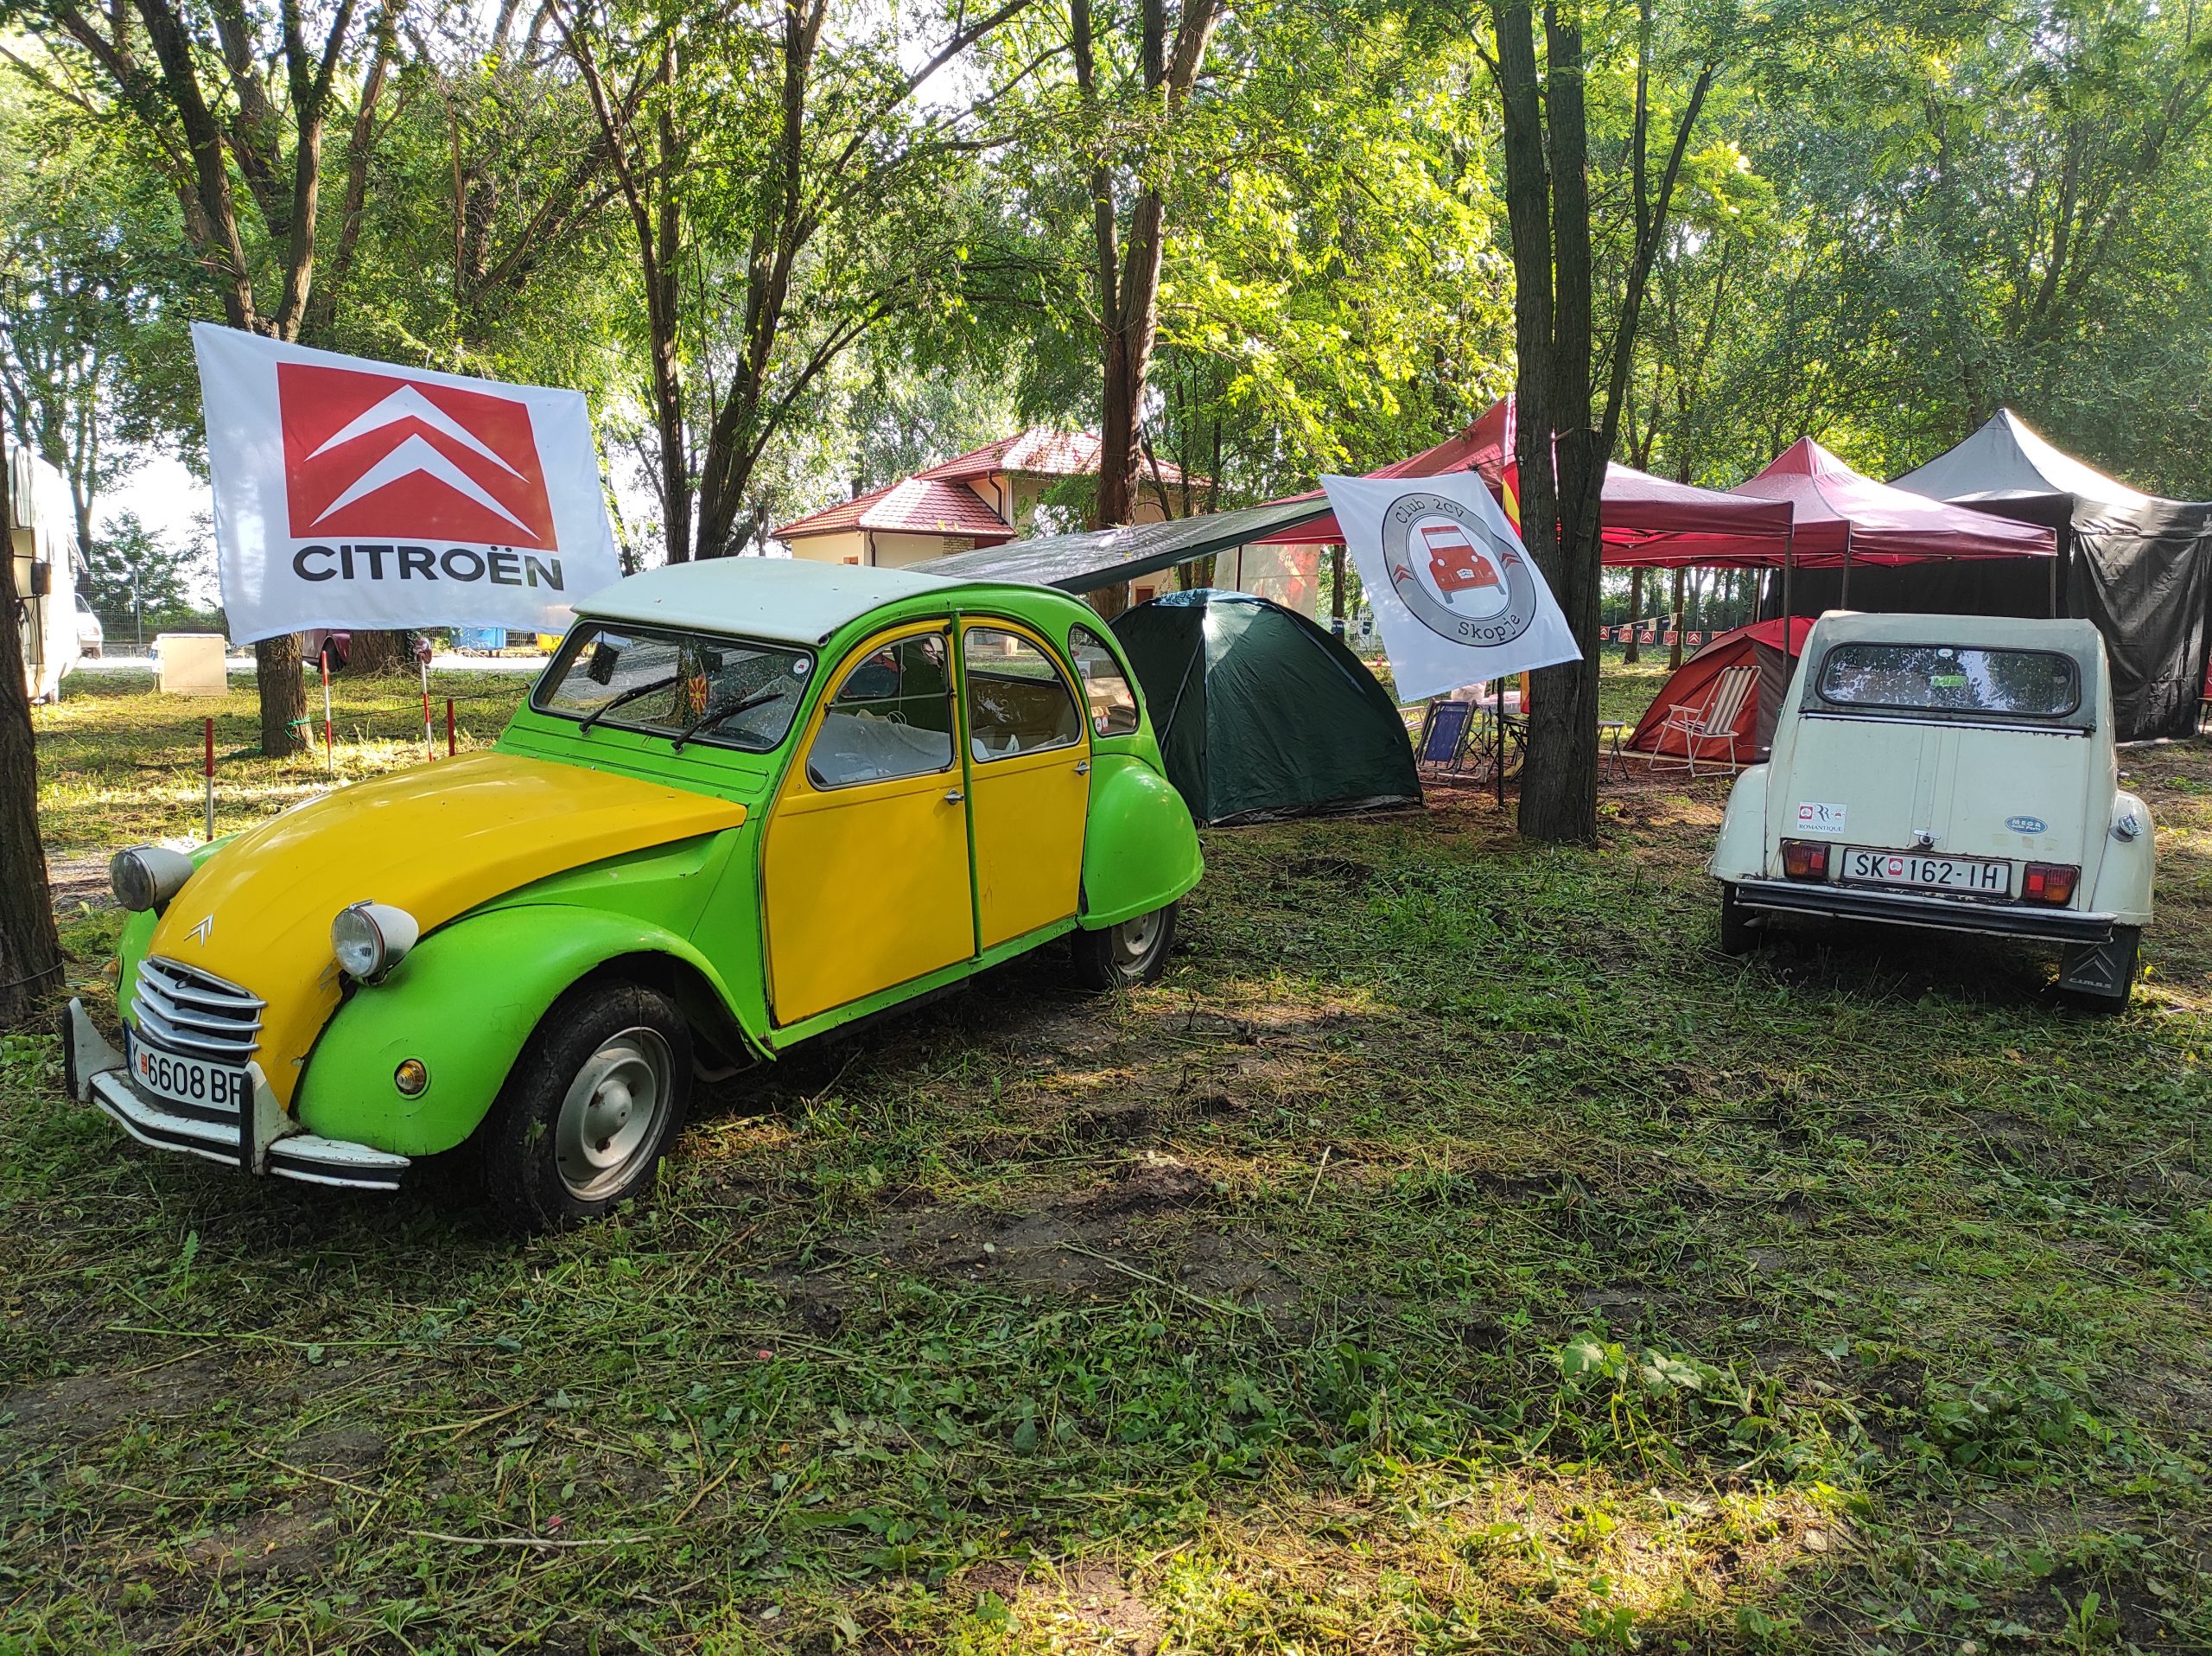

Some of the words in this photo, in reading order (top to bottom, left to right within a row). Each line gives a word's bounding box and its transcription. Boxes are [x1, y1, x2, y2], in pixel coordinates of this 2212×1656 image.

[1395, 499, 1426, 524] Club
[1433, 499, 1465, 518] 2CV
[292, 545, 564, 591] CITROËN
[1459, 614, 1521, 641] Skopje
[2012, 818, 2041, 827] MEGA
[1855, 854, 1885, 878] SK
[1910, 859, 1998, 889] 162-IH
[148, 1053, 206, 1099] 6608
